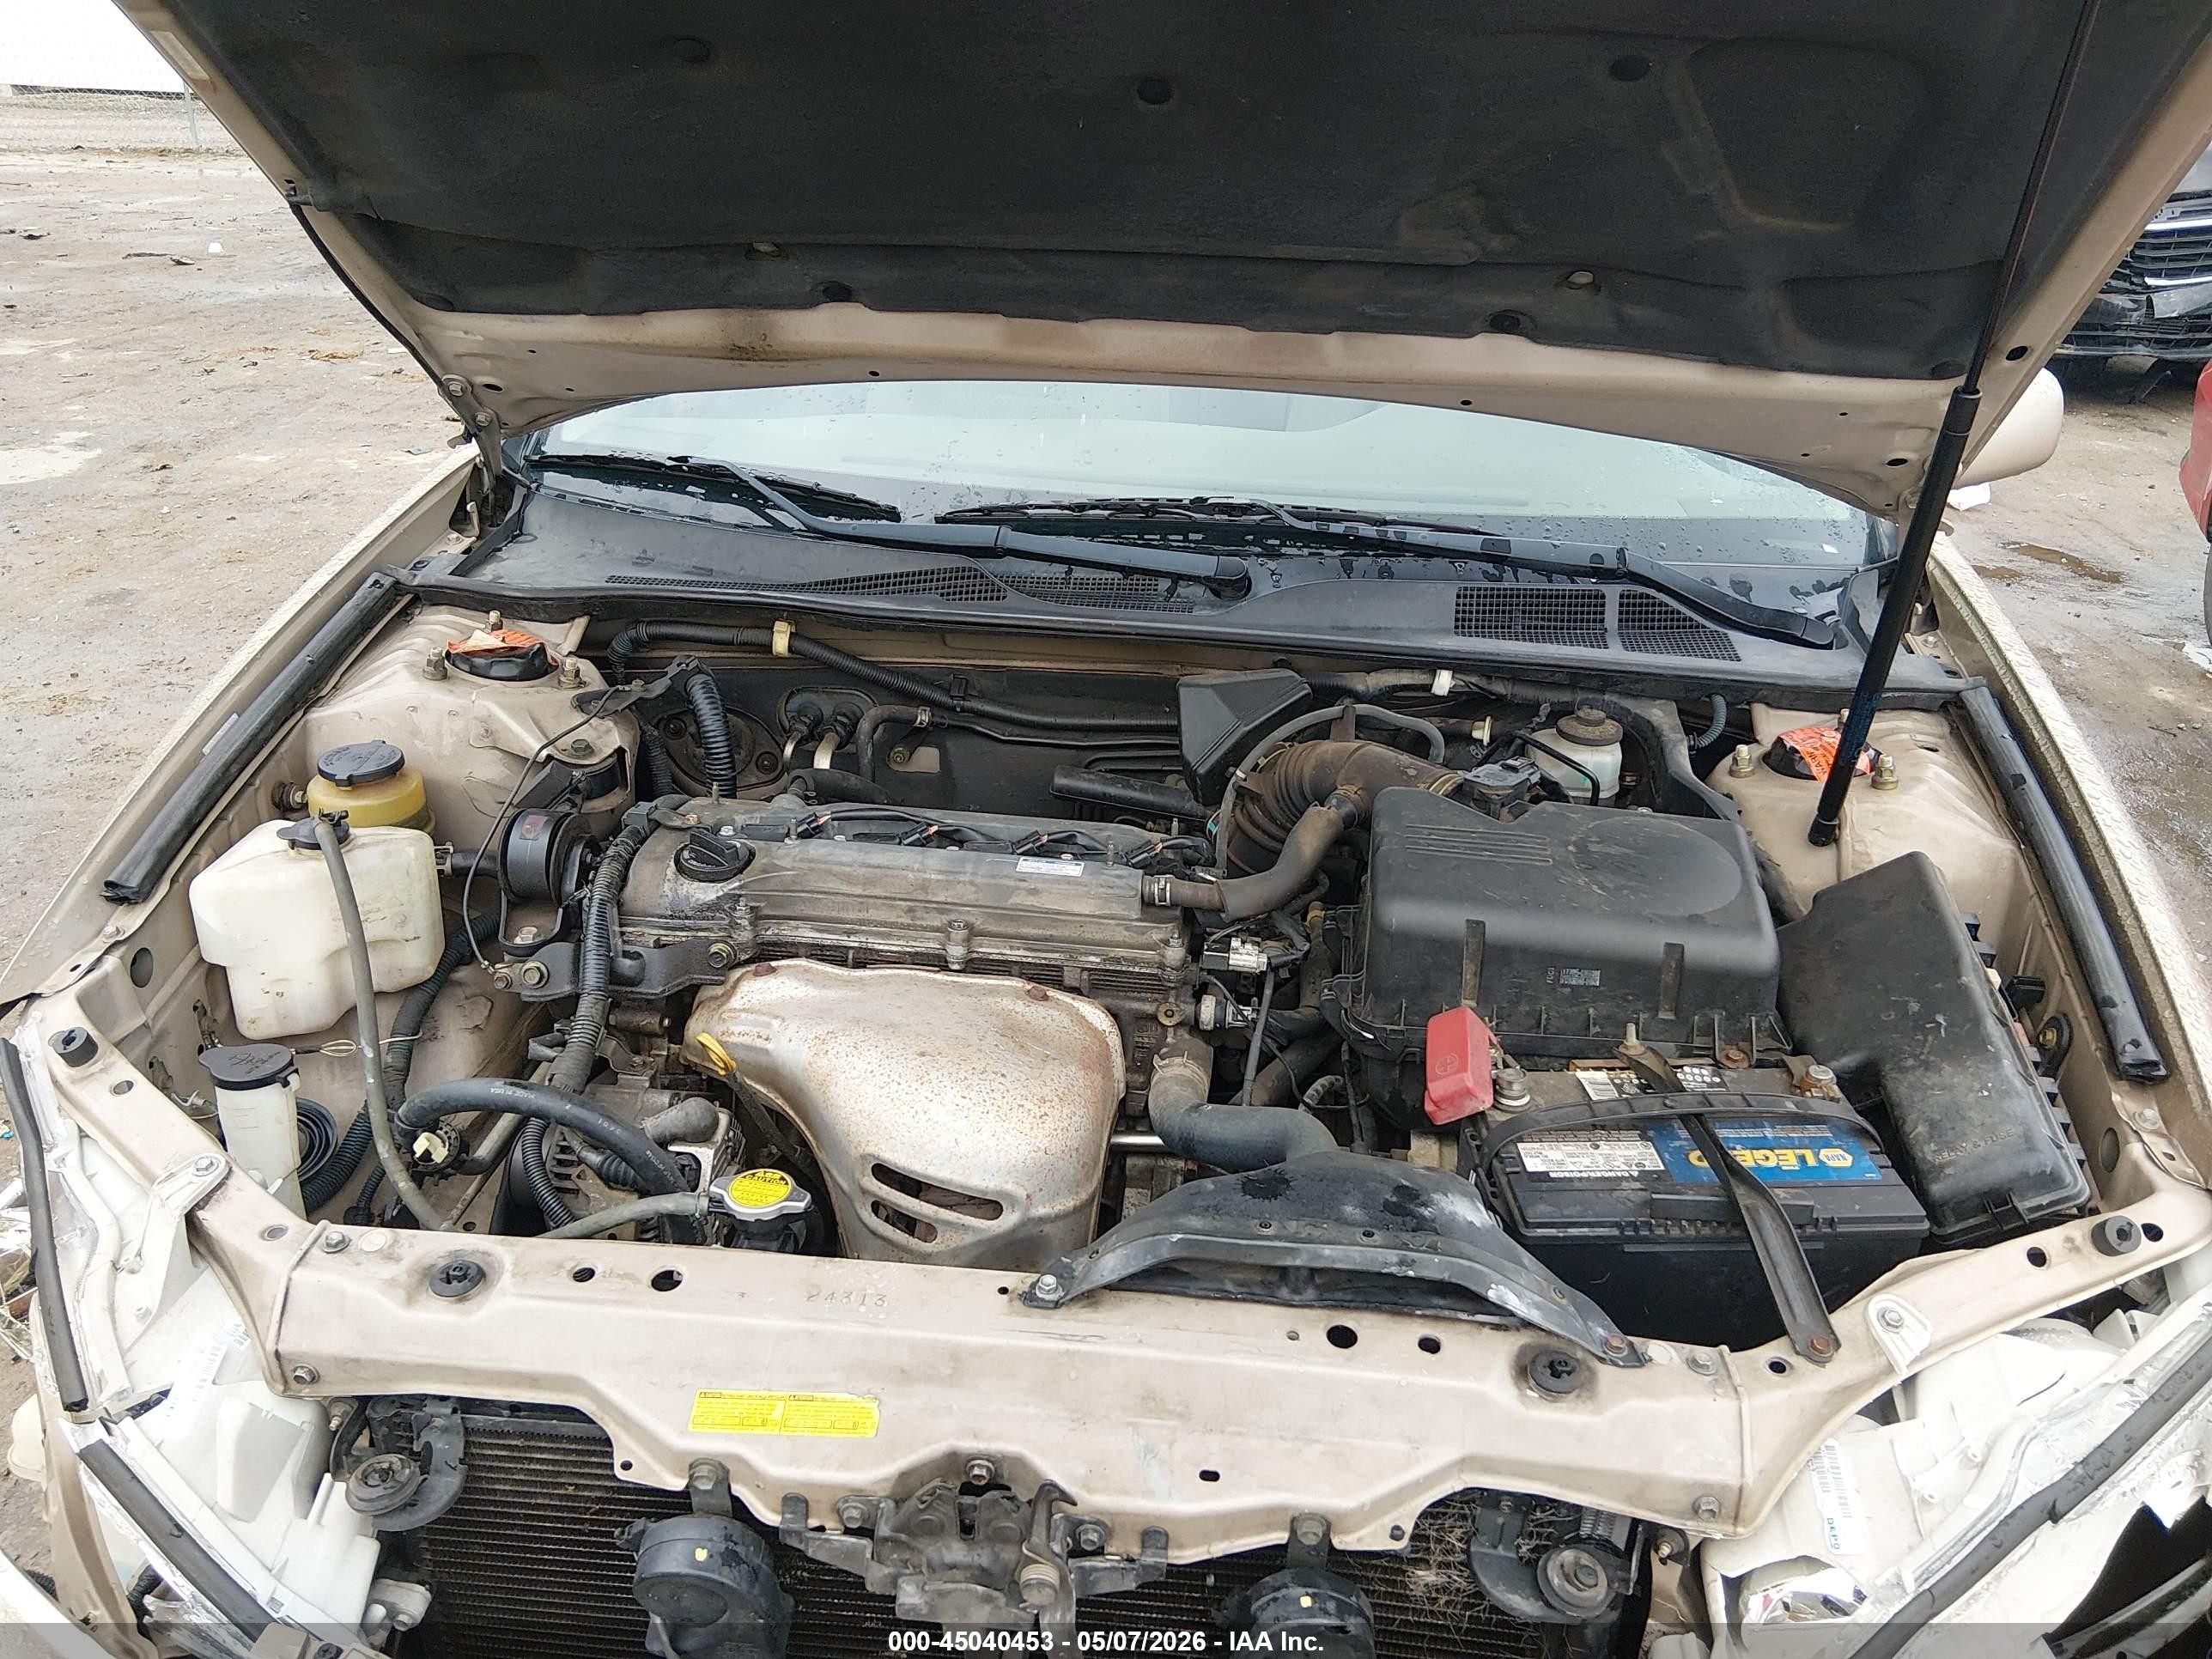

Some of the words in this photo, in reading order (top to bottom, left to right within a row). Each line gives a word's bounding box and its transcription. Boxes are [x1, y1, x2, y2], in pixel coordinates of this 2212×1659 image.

[1688, 1148, 1819, 1167] LEGED
[1932, 1143, 1967, 1163] RELAY
[1984, 1127, 2014, 1146] FUSE
[745, 1175, 787, 1186] CAUTION
[1826, 1517, 1840, 1550] DEPO
